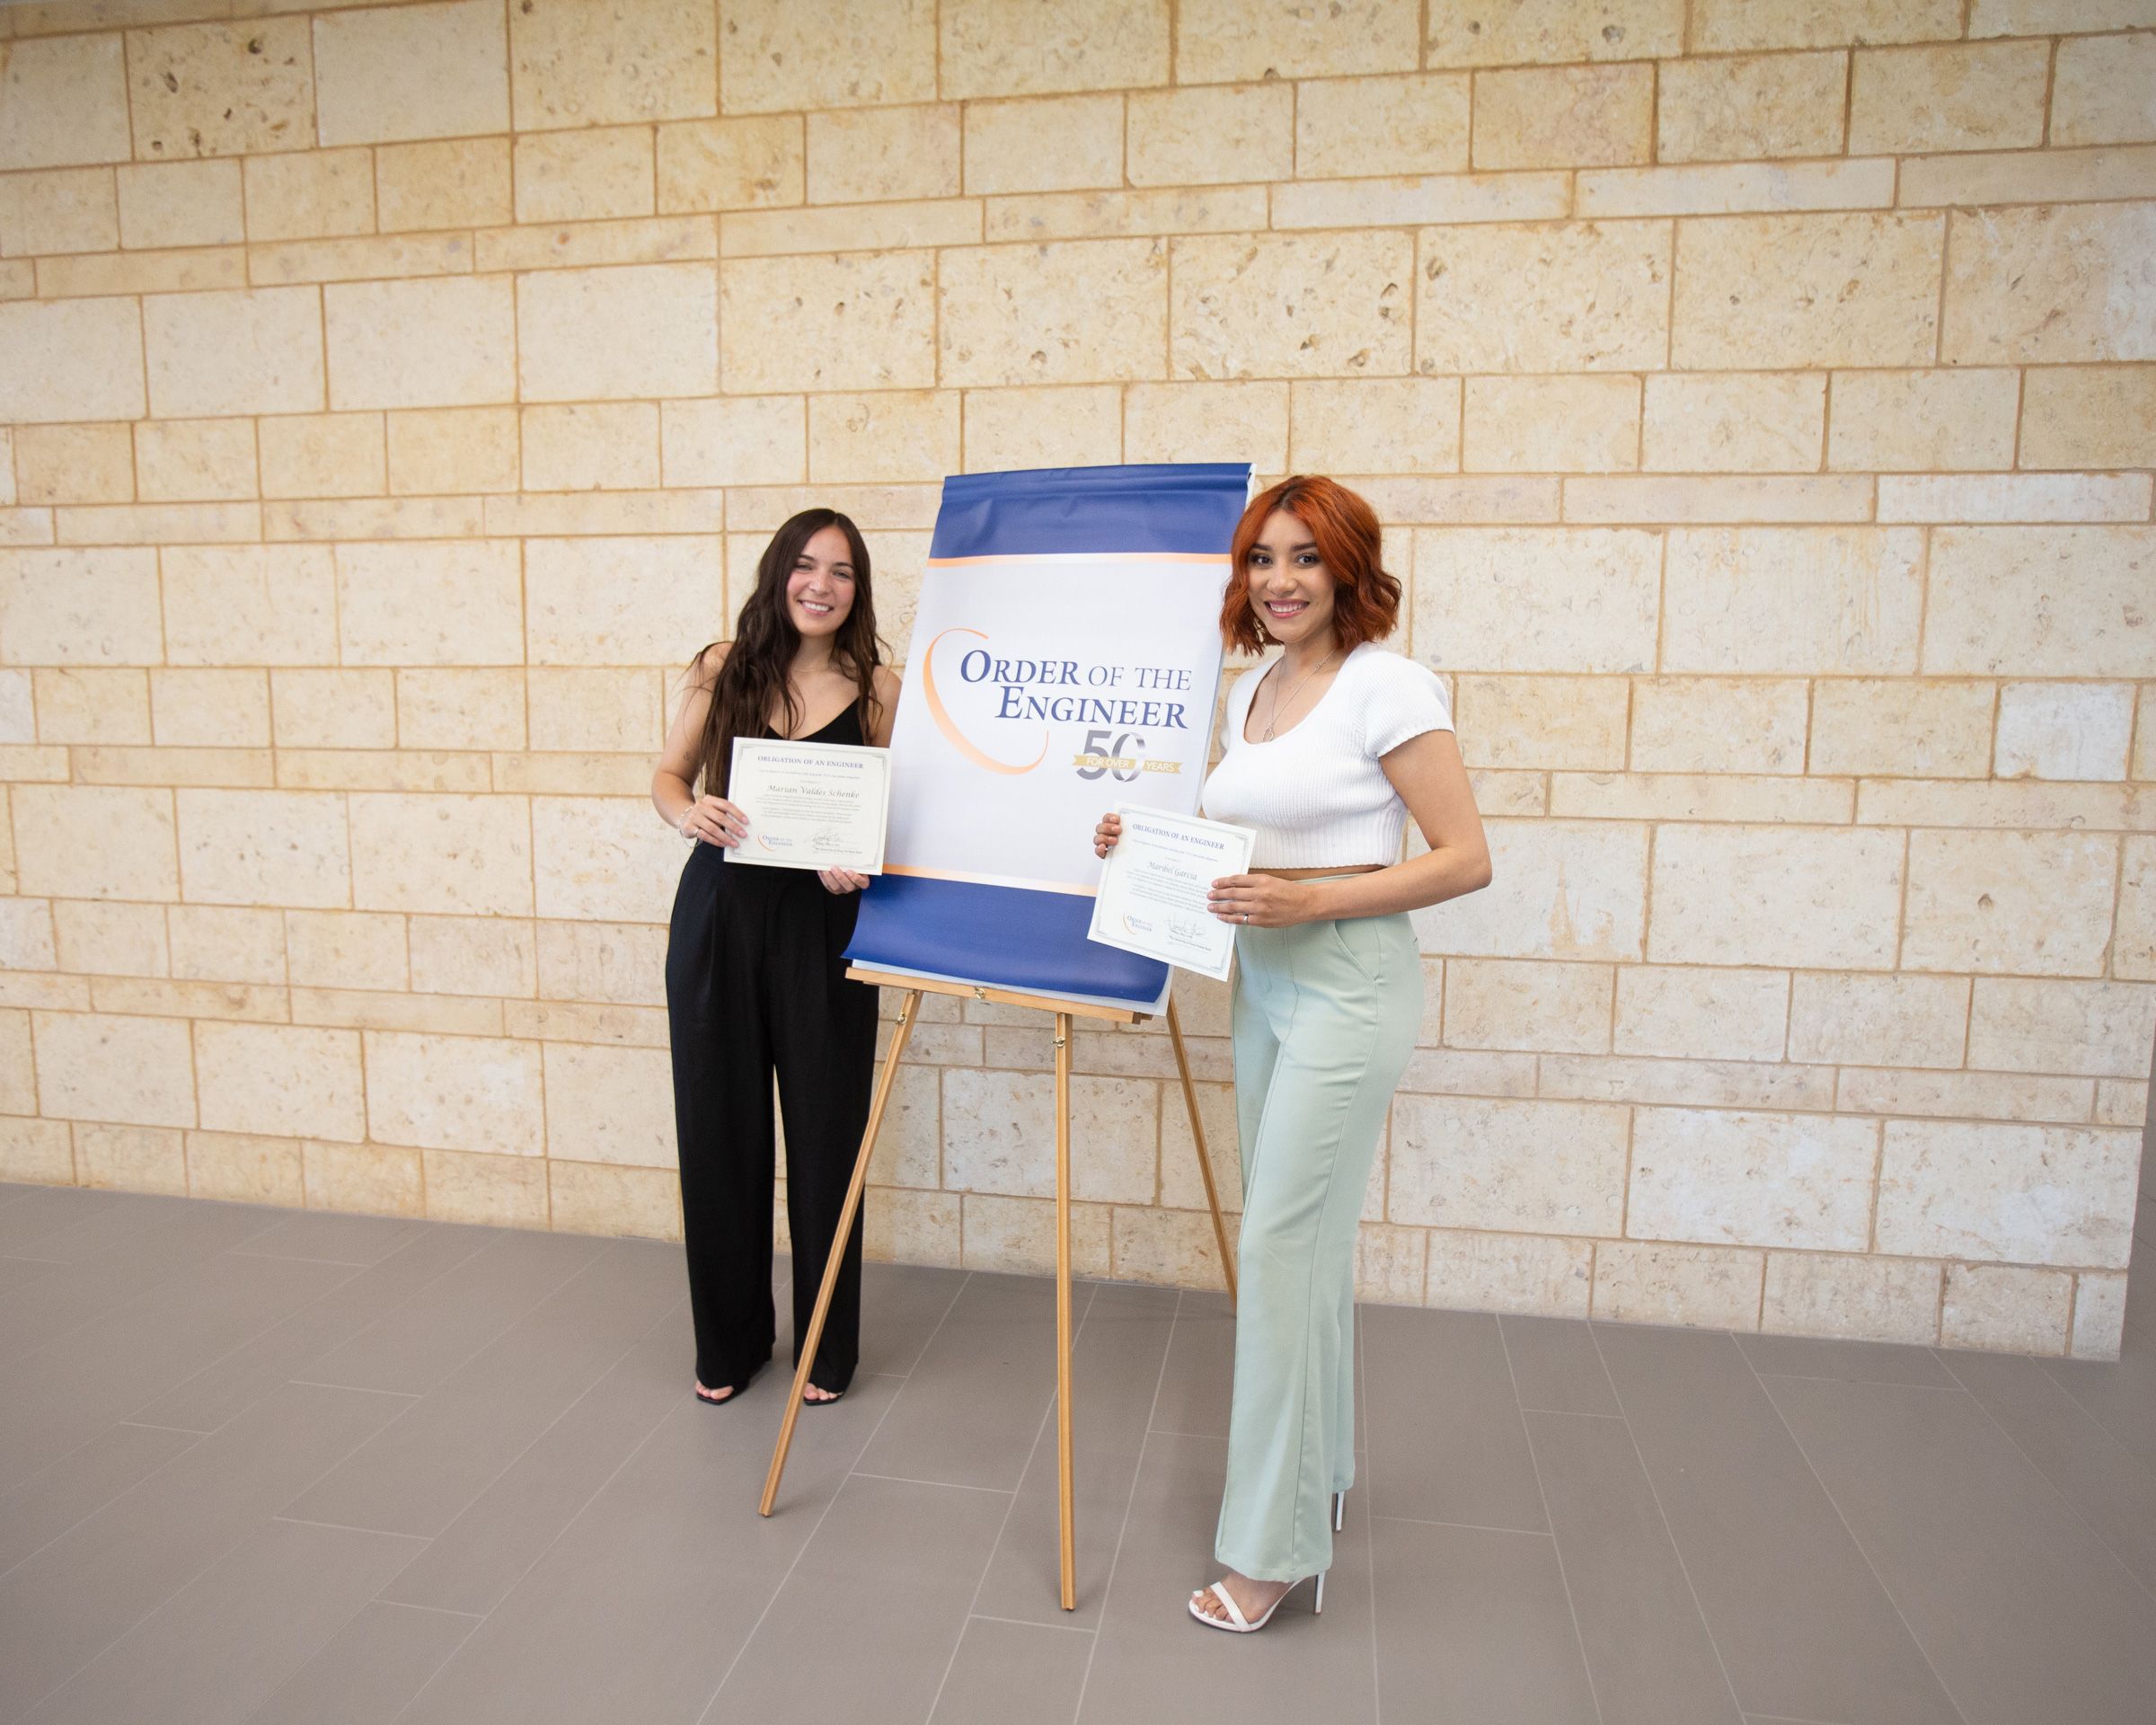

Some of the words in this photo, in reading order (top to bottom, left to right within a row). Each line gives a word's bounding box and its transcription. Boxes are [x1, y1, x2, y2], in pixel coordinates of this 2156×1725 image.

[960, 650, 1081, 686] ORDER
[1088, 666, 1124, 686] OF
[1135, 667, 1192, 691] THE
[995, 686, 1188, 730] ENGINEER
[757, 755, 801, 765] OBLIGATION
[826, 760, 863, 769] ENGINEER
[1076, 730, 1146, 783] 50
[1086, 757, 1104, 766] FOR
[1106, 758, 1129, 768] OVER
[1146, 762, 1174, 773] YEARS
[766, 784, 798, 793] Marian
[800, 786, 826, 796] Valdes
[827, 789, 860, 799] Schenke
[1132, 823, 1171, 838] OBLIGATION
[1171, 832, 1180, 840] OF
[1180, 834, 1190, 842] AN
[1190, 836, 1224, 850] ENGINEER
[1147, 861, 1173, 875] Maribel
[1174, 868, 1197, 881] Garcia
